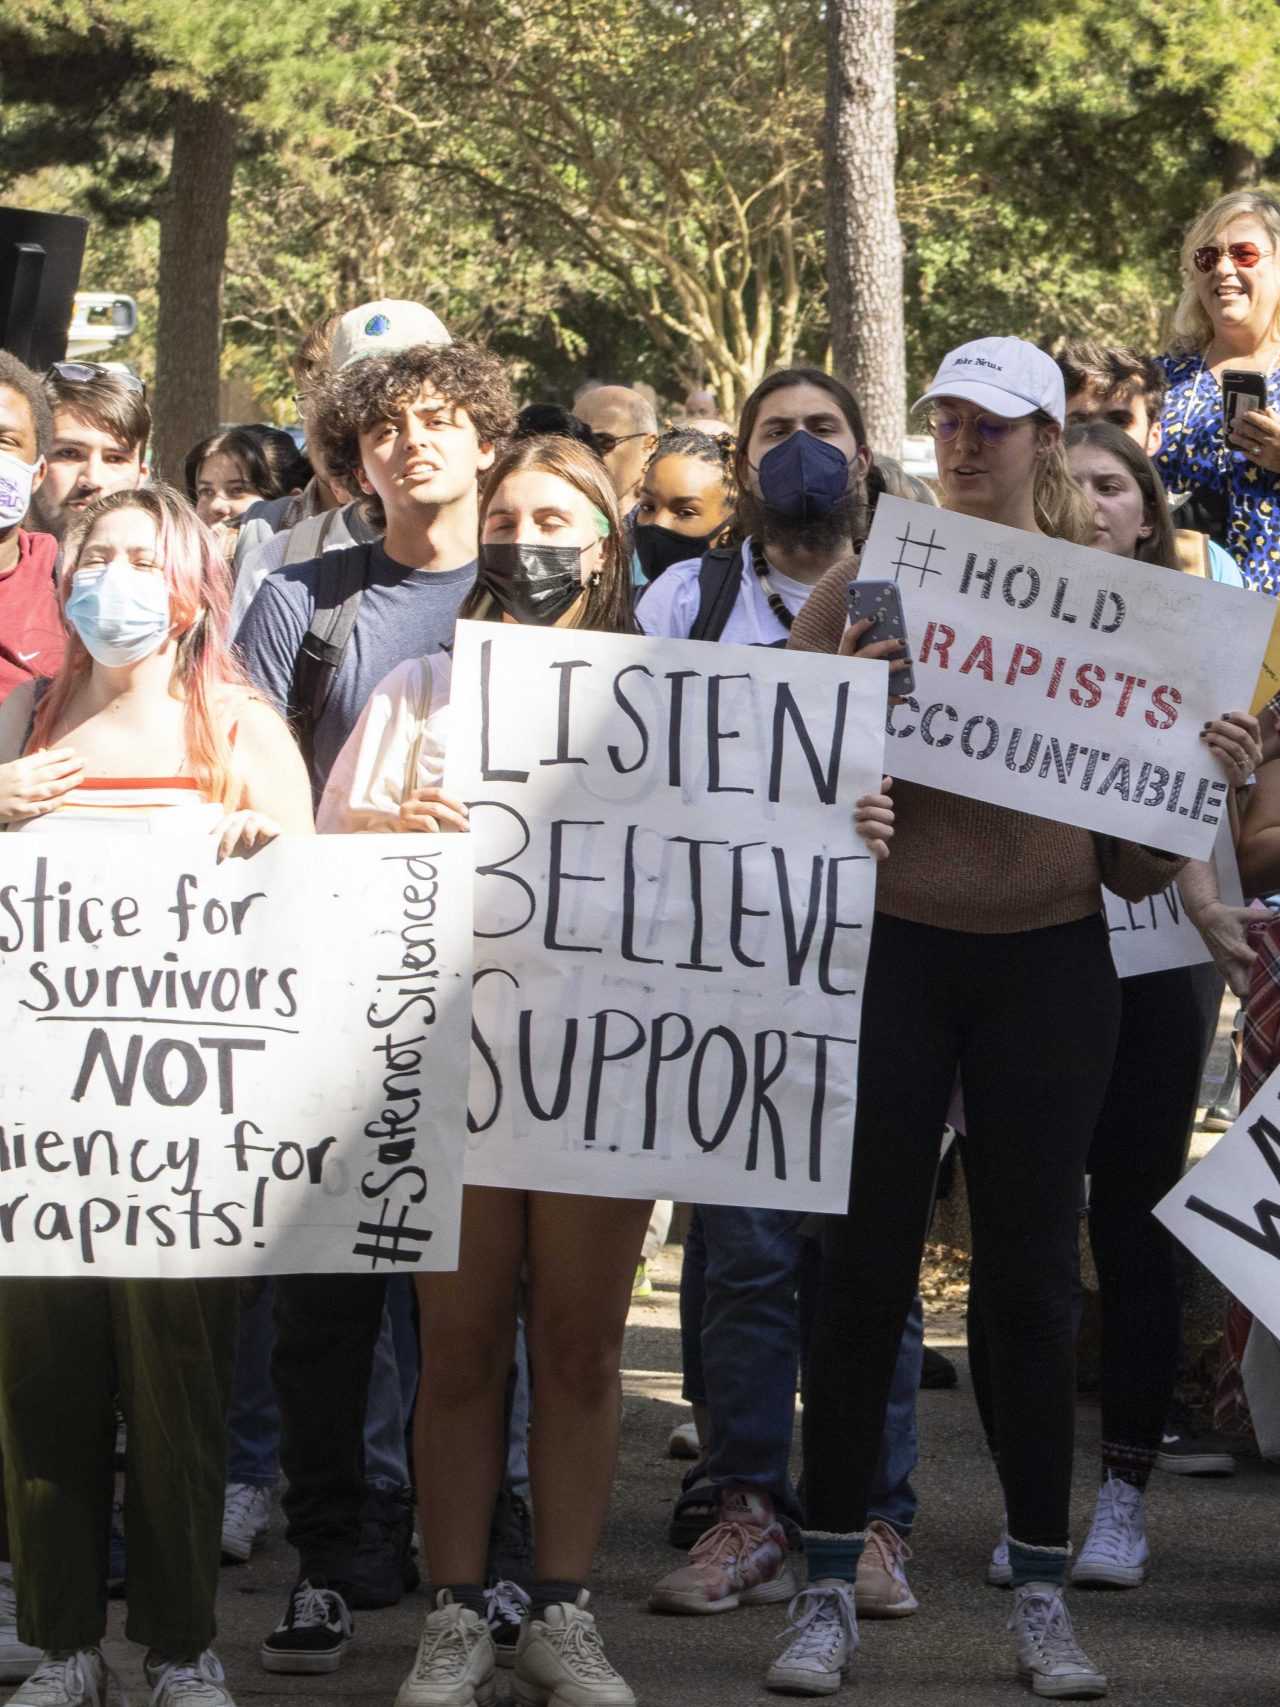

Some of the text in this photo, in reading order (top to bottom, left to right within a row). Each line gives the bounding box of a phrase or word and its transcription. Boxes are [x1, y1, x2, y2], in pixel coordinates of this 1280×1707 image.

[480, 640, 851, 804] LISTEN
[919, 621, 1183, 730] RAPISTS
[885, 696, 1227, 826] CCOUNTABLE
[168, 873, 267, 942] for
[463, 801, 871, 996] BELIEVE
[19, 952, 299, 1017] survivors
[71, 1028, 266, 1115] NOT
[466, 968, 858, 1183] SUPPORT
[225, 1120, 337, 1185] for
[0, 1177, 270, 1264] rapists!
